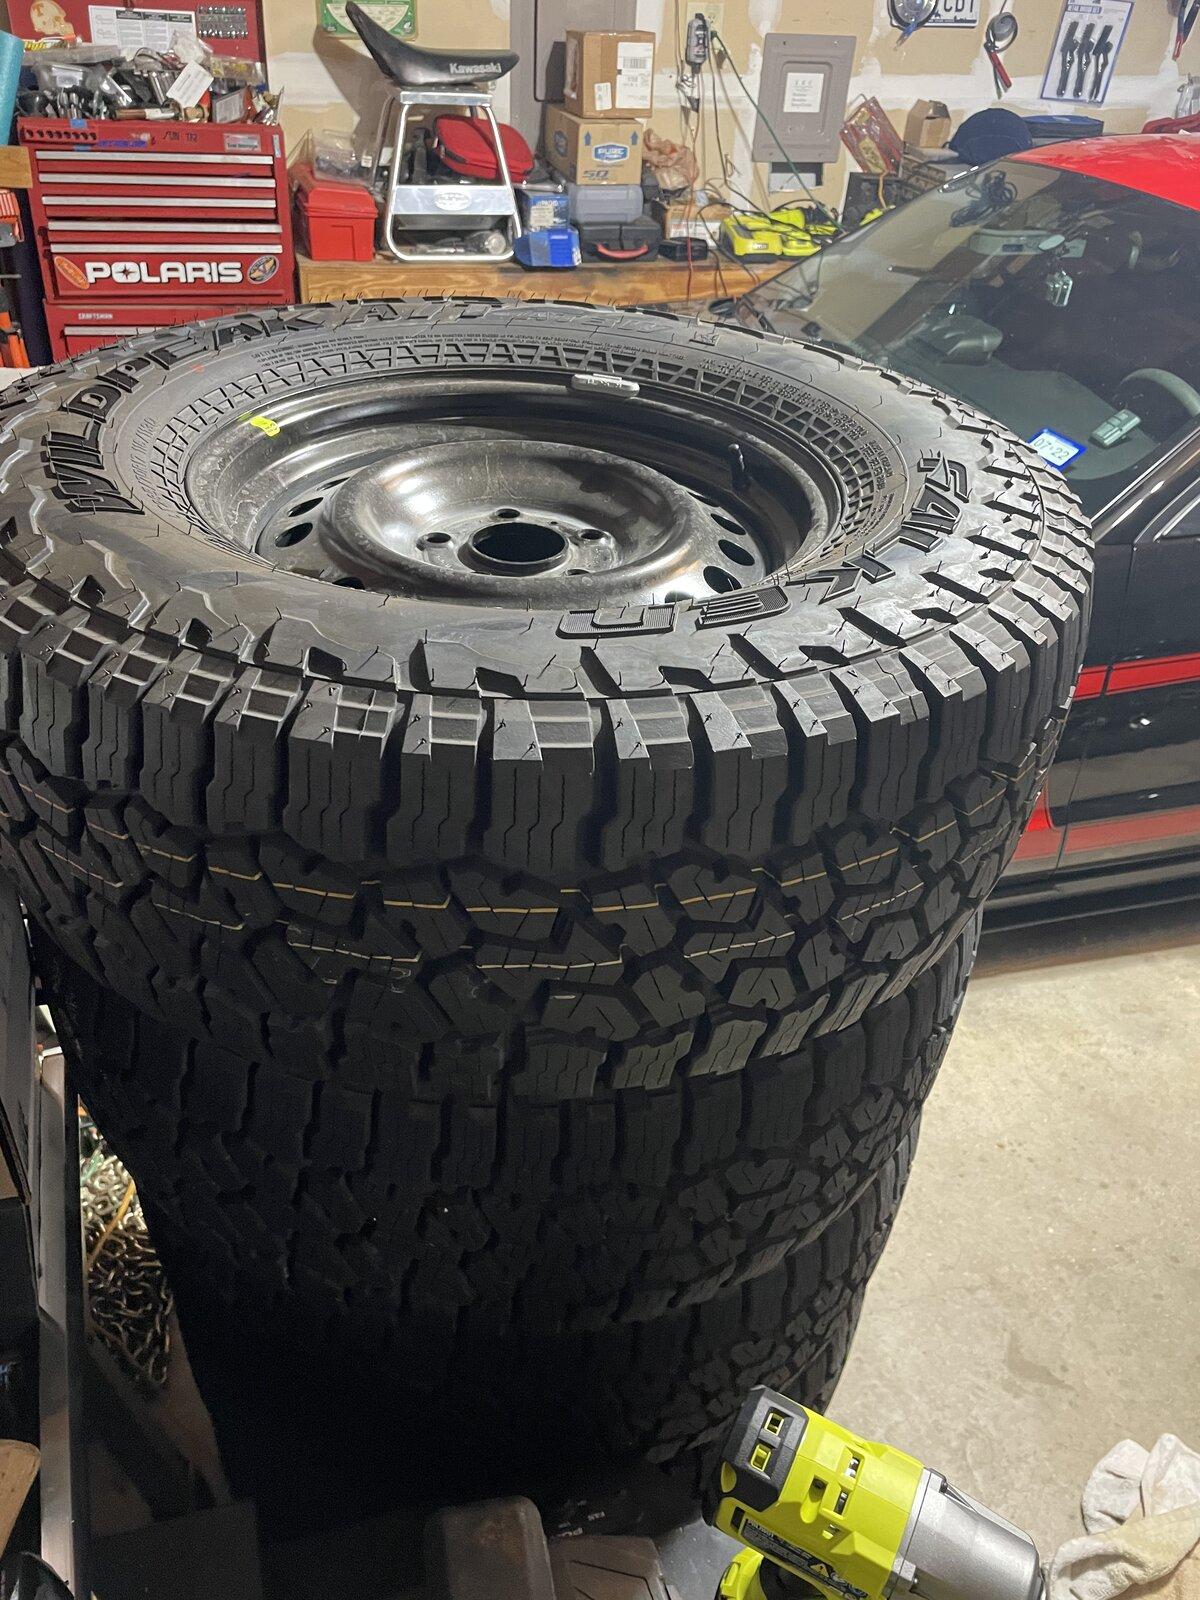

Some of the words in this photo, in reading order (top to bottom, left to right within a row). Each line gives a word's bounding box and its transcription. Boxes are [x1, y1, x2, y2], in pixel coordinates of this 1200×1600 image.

[449, 62, 502, 75] Kawasaki
[85, 261, 243, 284] POLARIS
[44, 306, 324, 515] WILDPEAK
